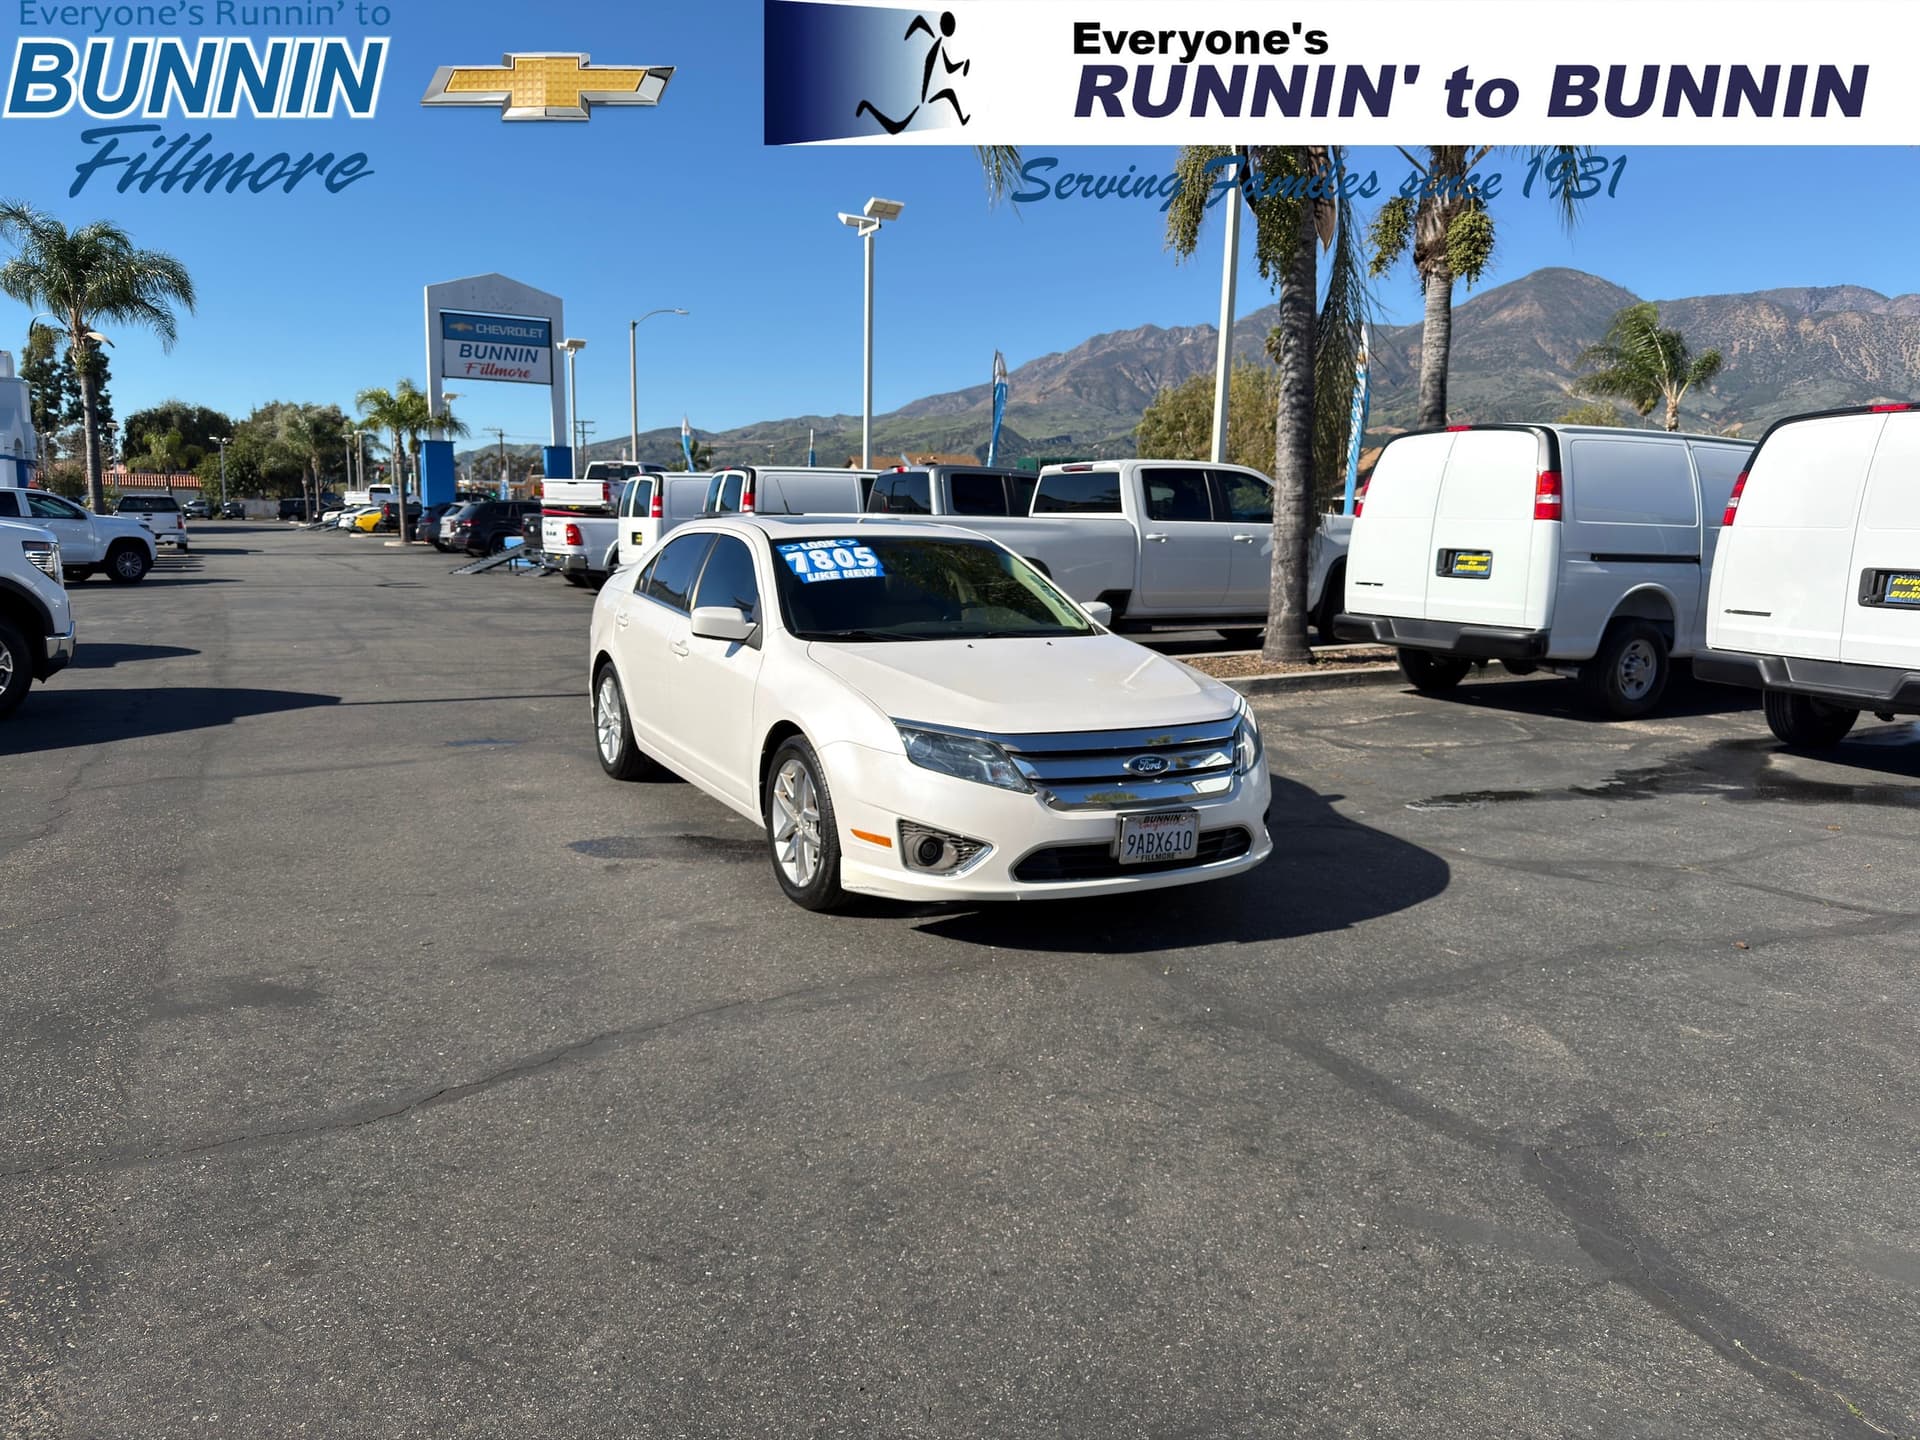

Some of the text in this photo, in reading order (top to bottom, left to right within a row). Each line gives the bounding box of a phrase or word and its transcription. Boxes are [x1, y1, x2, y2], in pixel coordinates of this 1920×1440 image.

[475, 323, 544, 339] CHEVROLET
[459, 343, 539, 363] BUNNIN
[465, 362, 530, 379] Fillmore
[800, 540, 840, 550] LOOK
[785, 547, 878, 573] 7805
[806, 568, 877, 582] LIKE NEW
[1138, 759, 1162, 771] Ford
[1143, 814, 1181, 824] BUNNIN
[1127, 830, 1193, 856] 9ABX610
